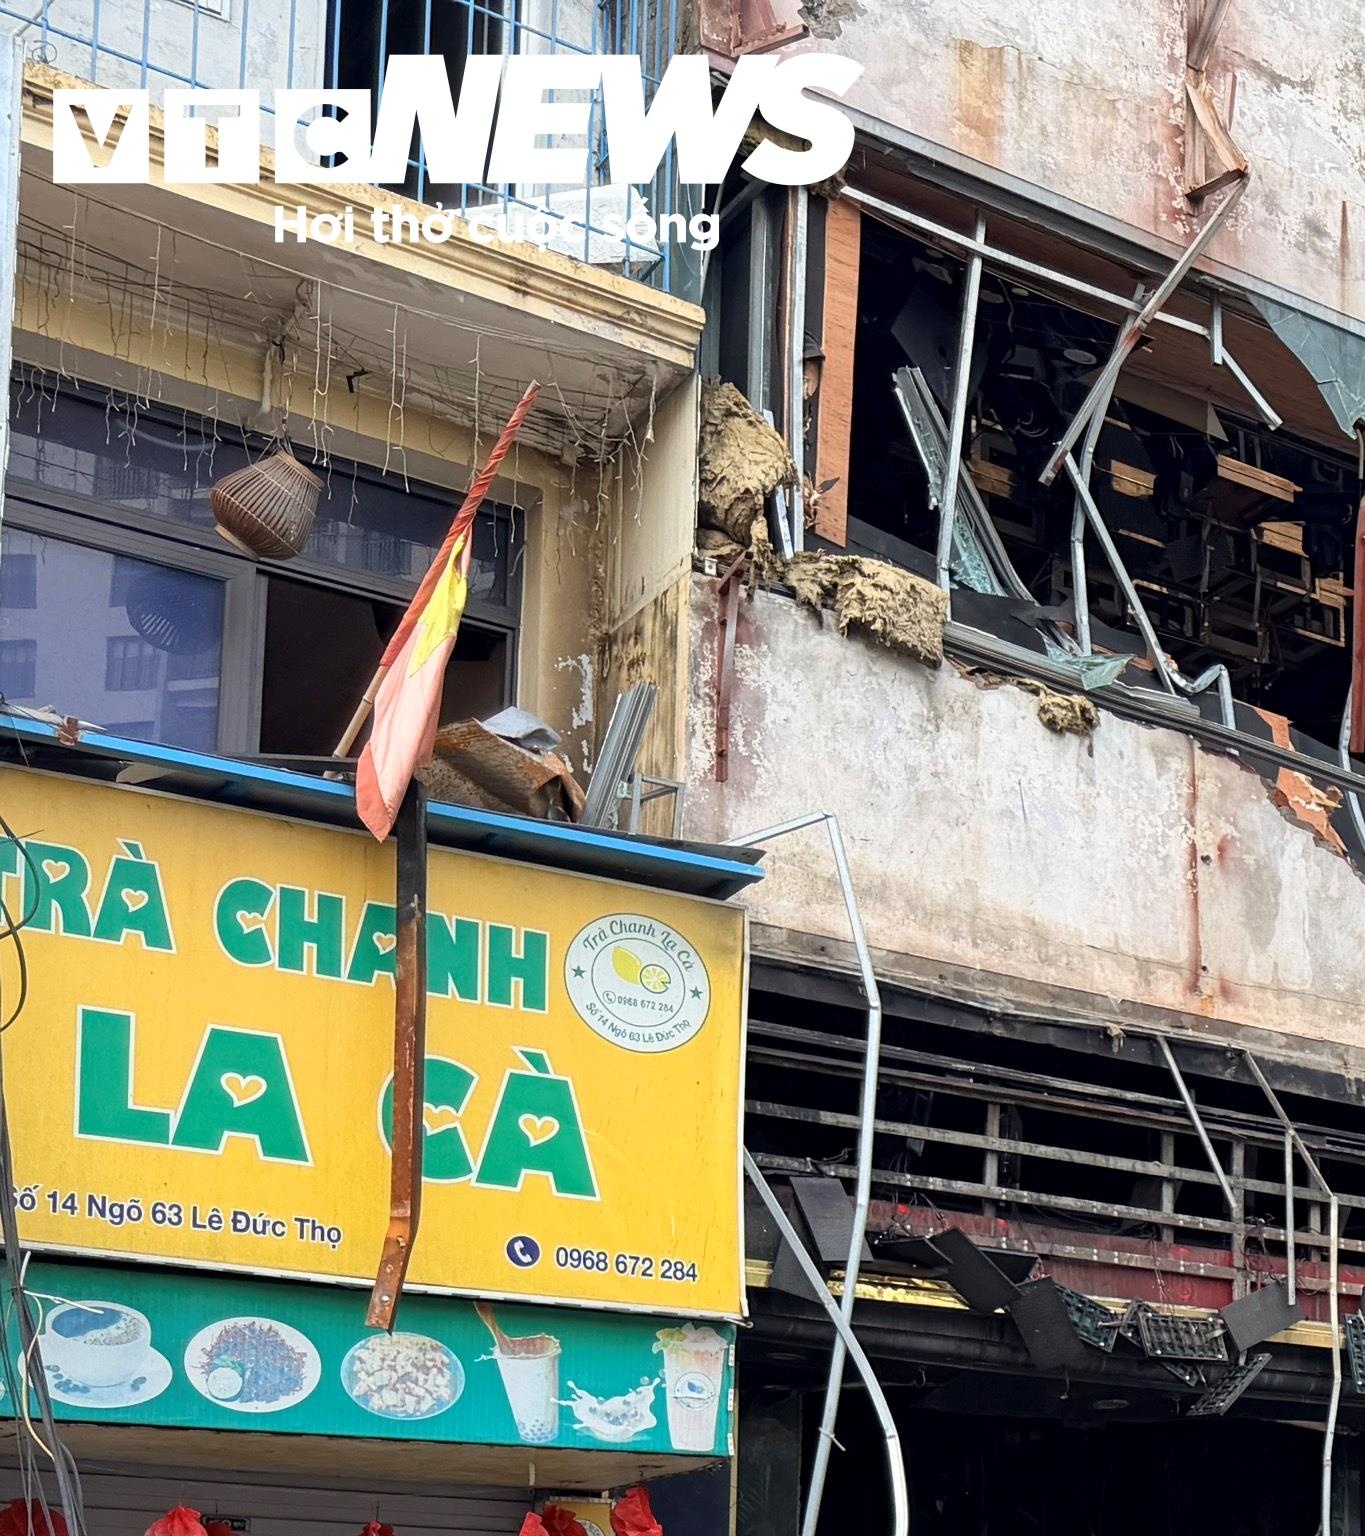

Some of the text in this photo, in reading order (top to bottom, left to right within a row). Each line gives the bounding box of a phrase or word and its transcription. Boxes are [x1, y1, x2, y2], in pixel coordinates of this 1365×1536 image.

[213, 876, 550, 1013] CHANH
[609, 919, 656, 938] Chanh
[74, 1003, 602, 1201] LA CÀ
[47, 1190, 78, 1215] 14
[87, 1194, 143, 1226] Ngõ
[151, 1201, 183, 1227] 63
[191, 1206, 223, 1231] Lê
[231, 1209, 286, 1238] Đức
[294, 1217, 342, 1250] Thọ
[556, 1246, 698, 1283] 0968 672 284
